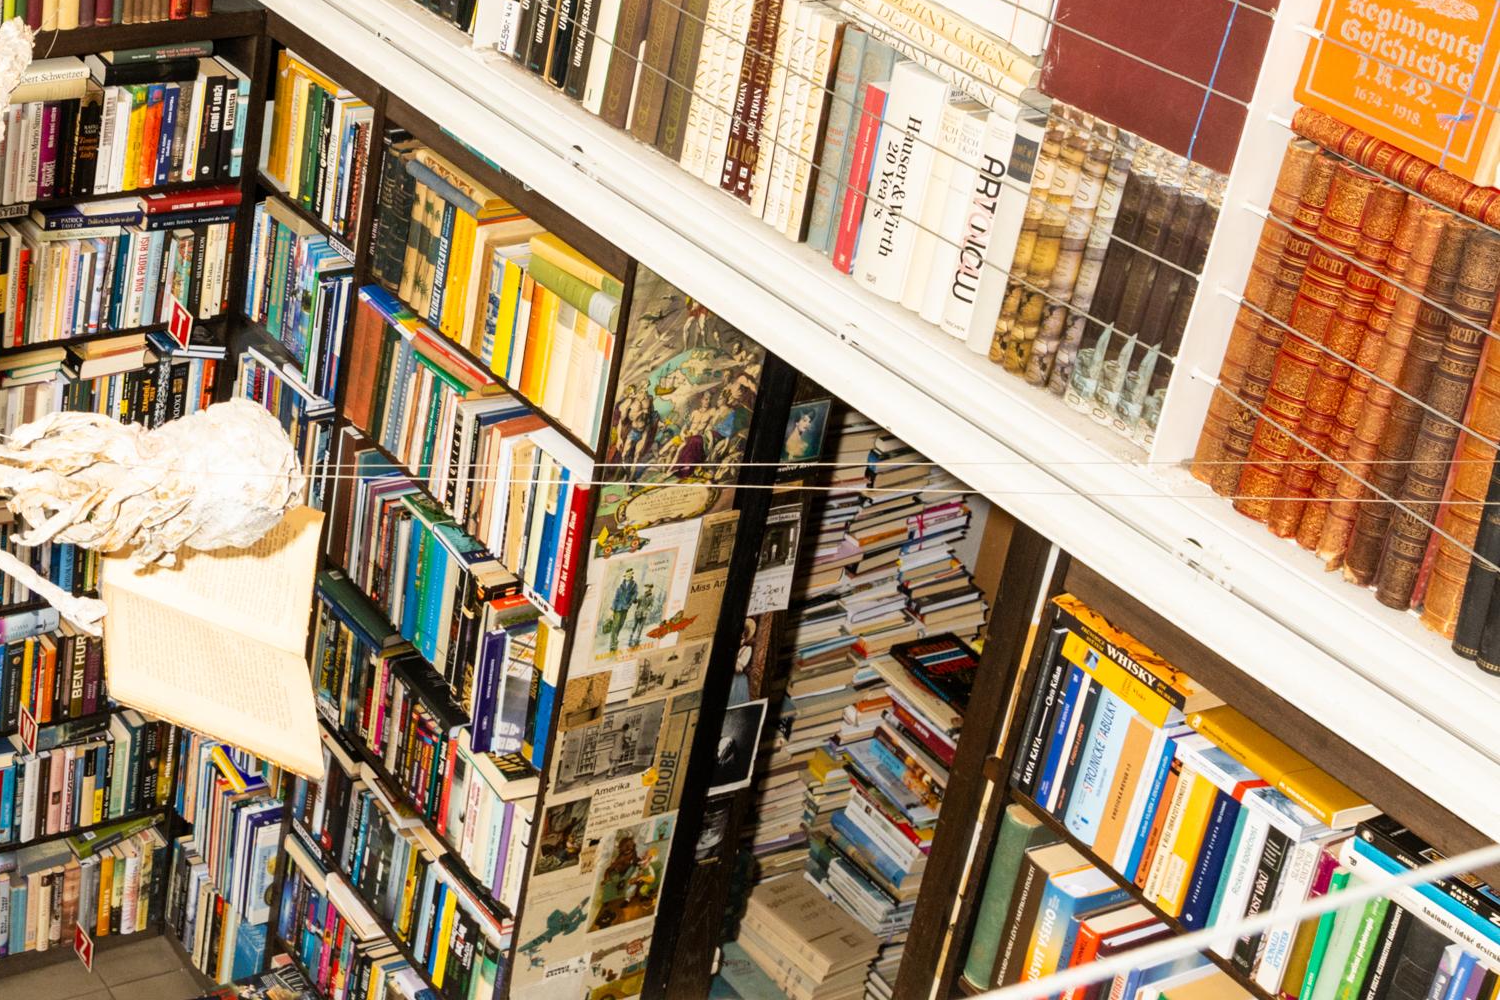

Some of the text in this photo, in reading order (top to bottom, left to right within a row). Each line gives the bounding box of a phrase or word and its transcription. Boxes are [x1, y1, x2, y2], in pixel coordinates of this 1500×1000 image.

[886, 141, 899, 164] 20
[878, 115, 923, 257] Hauser & Wirth
[172, 312, 186, 340] T
[71, 635, 87, 699] BEN HUR
[1106, 644, 1157, 686] WHISKY
[21, 718, 36, 745] W
[1098, 698, 1118, 743] TABULKY
[593, 781, 630, 797] Amerika
[75, 934, 91, 960] Z
